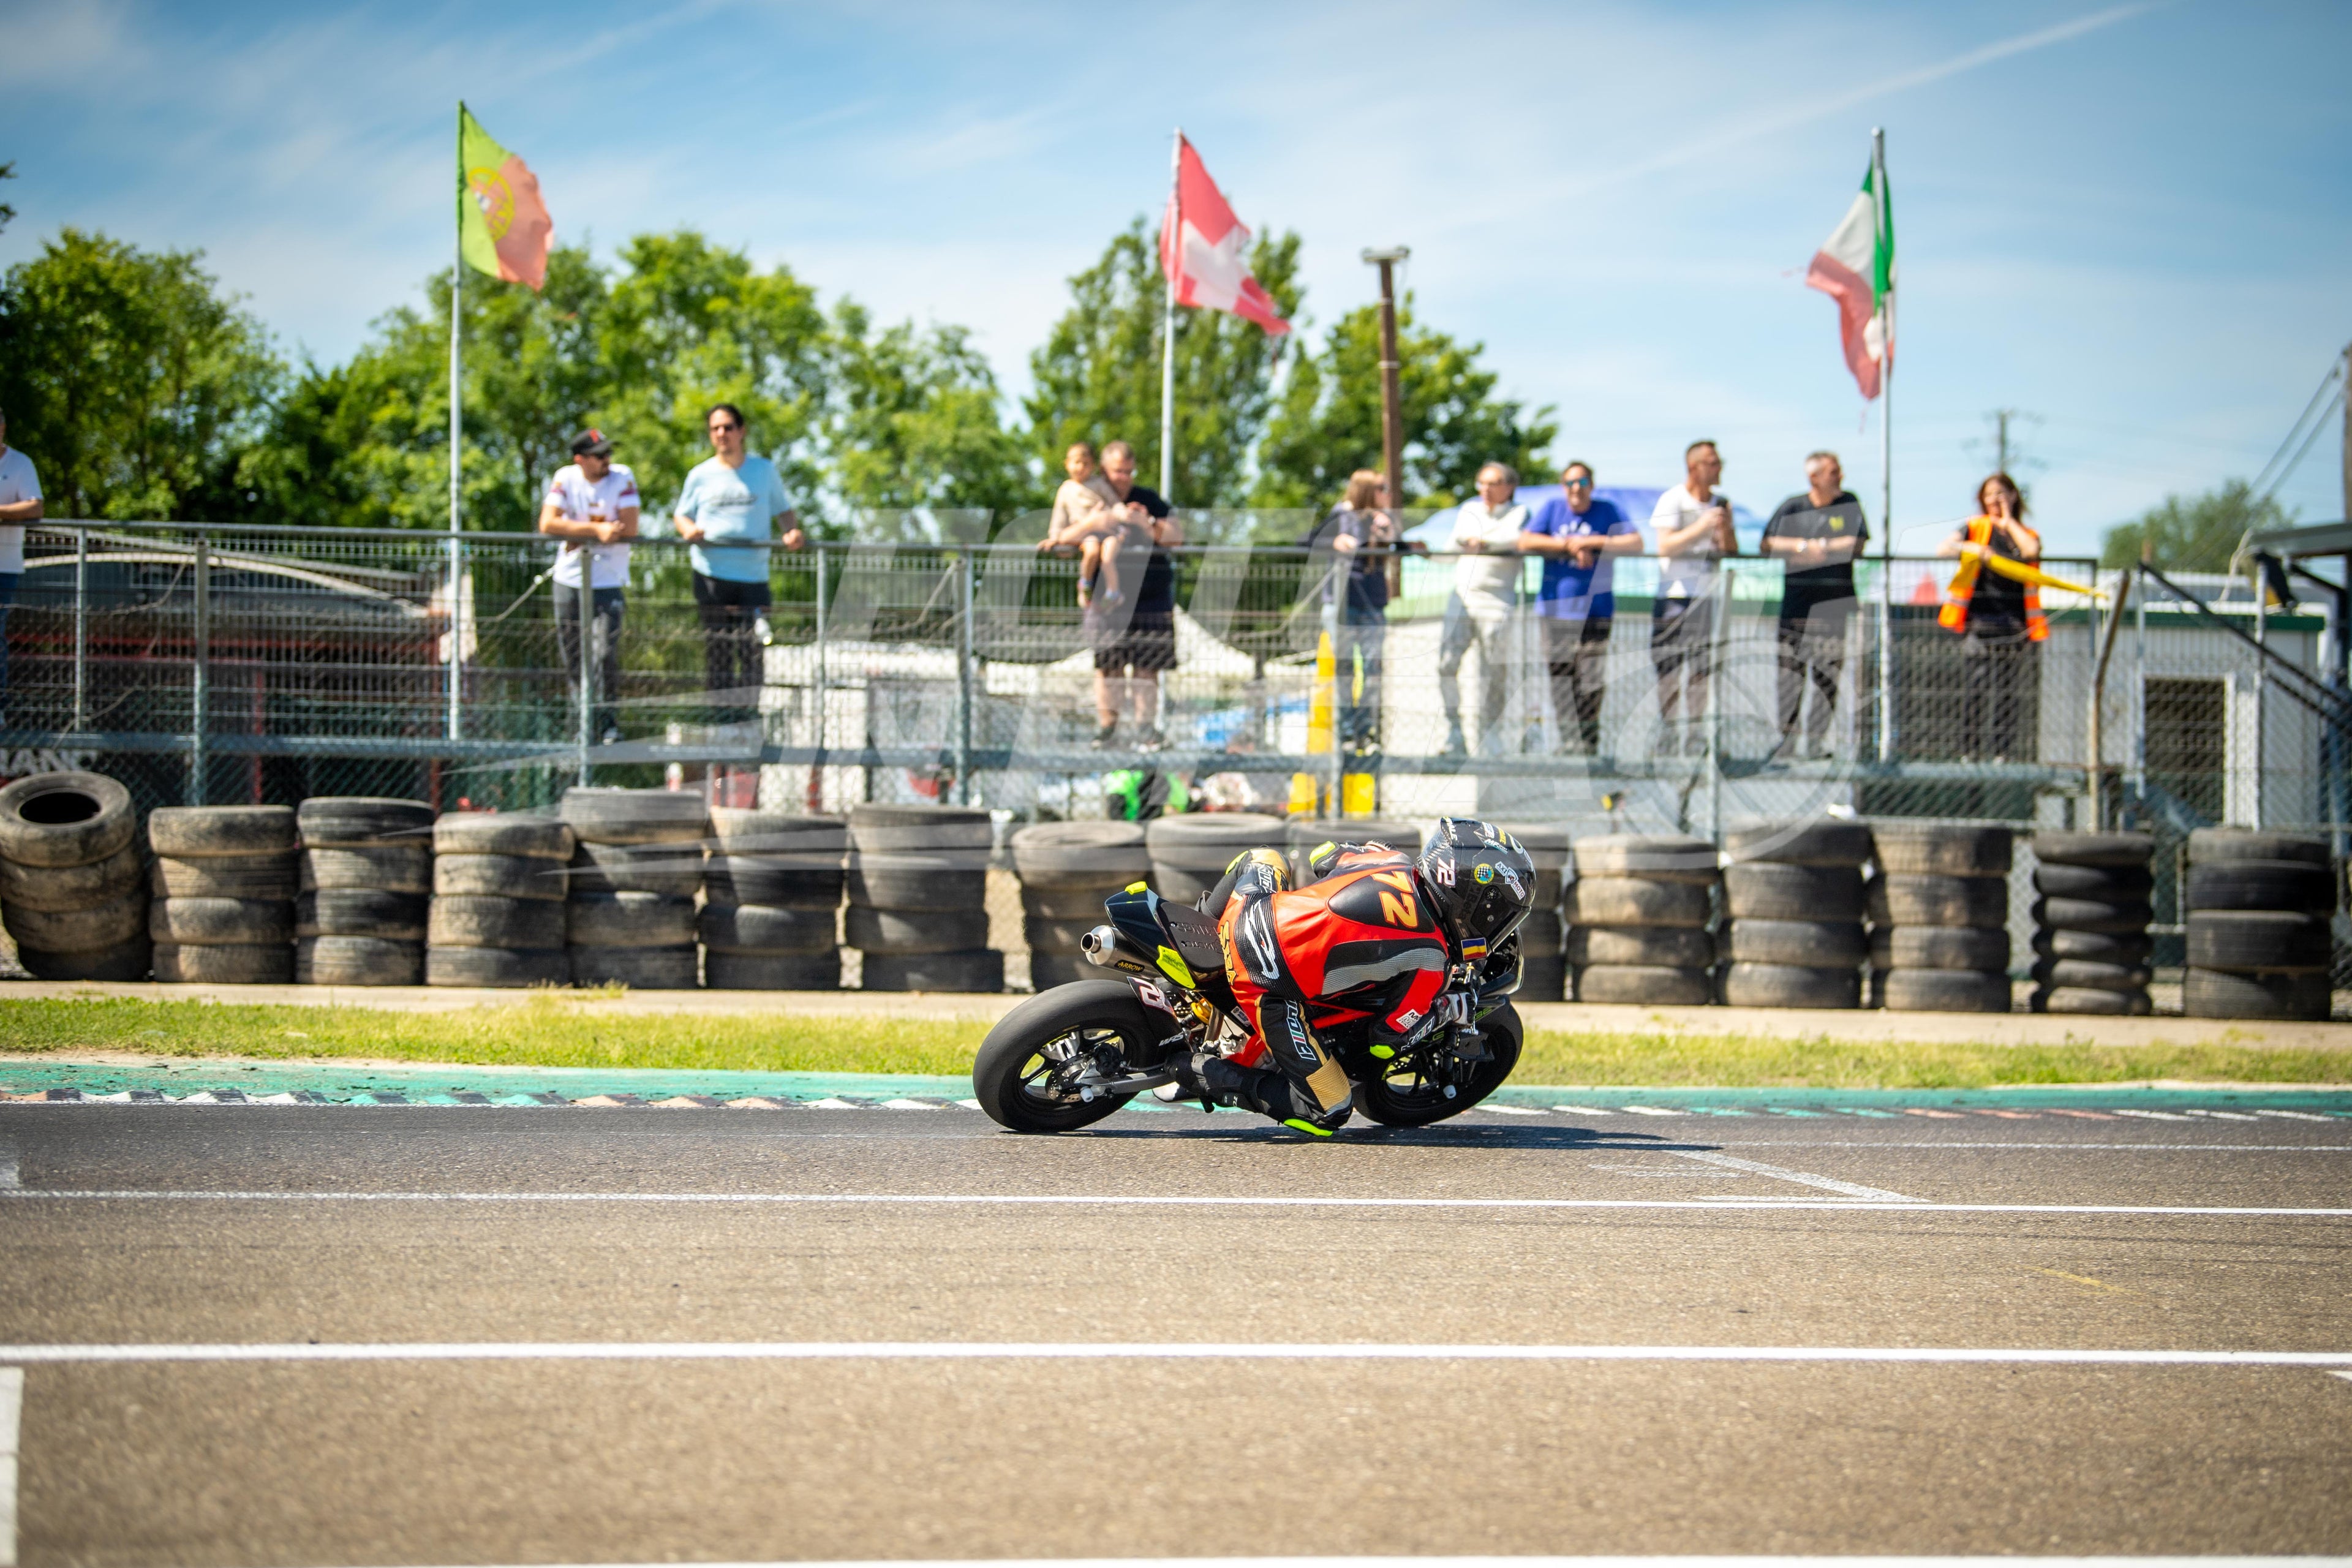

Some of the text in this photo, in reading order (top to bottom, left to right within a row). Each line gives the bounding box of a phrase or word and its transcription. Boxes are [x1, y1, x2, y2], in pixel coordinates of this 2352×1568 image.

[1437, 857, 1456, 888] 72
[1370, 870, 1419, 929] 72
[1513, 881, 1525, 899] MOTO
[1117, 960, 1144, 971] ARROW
